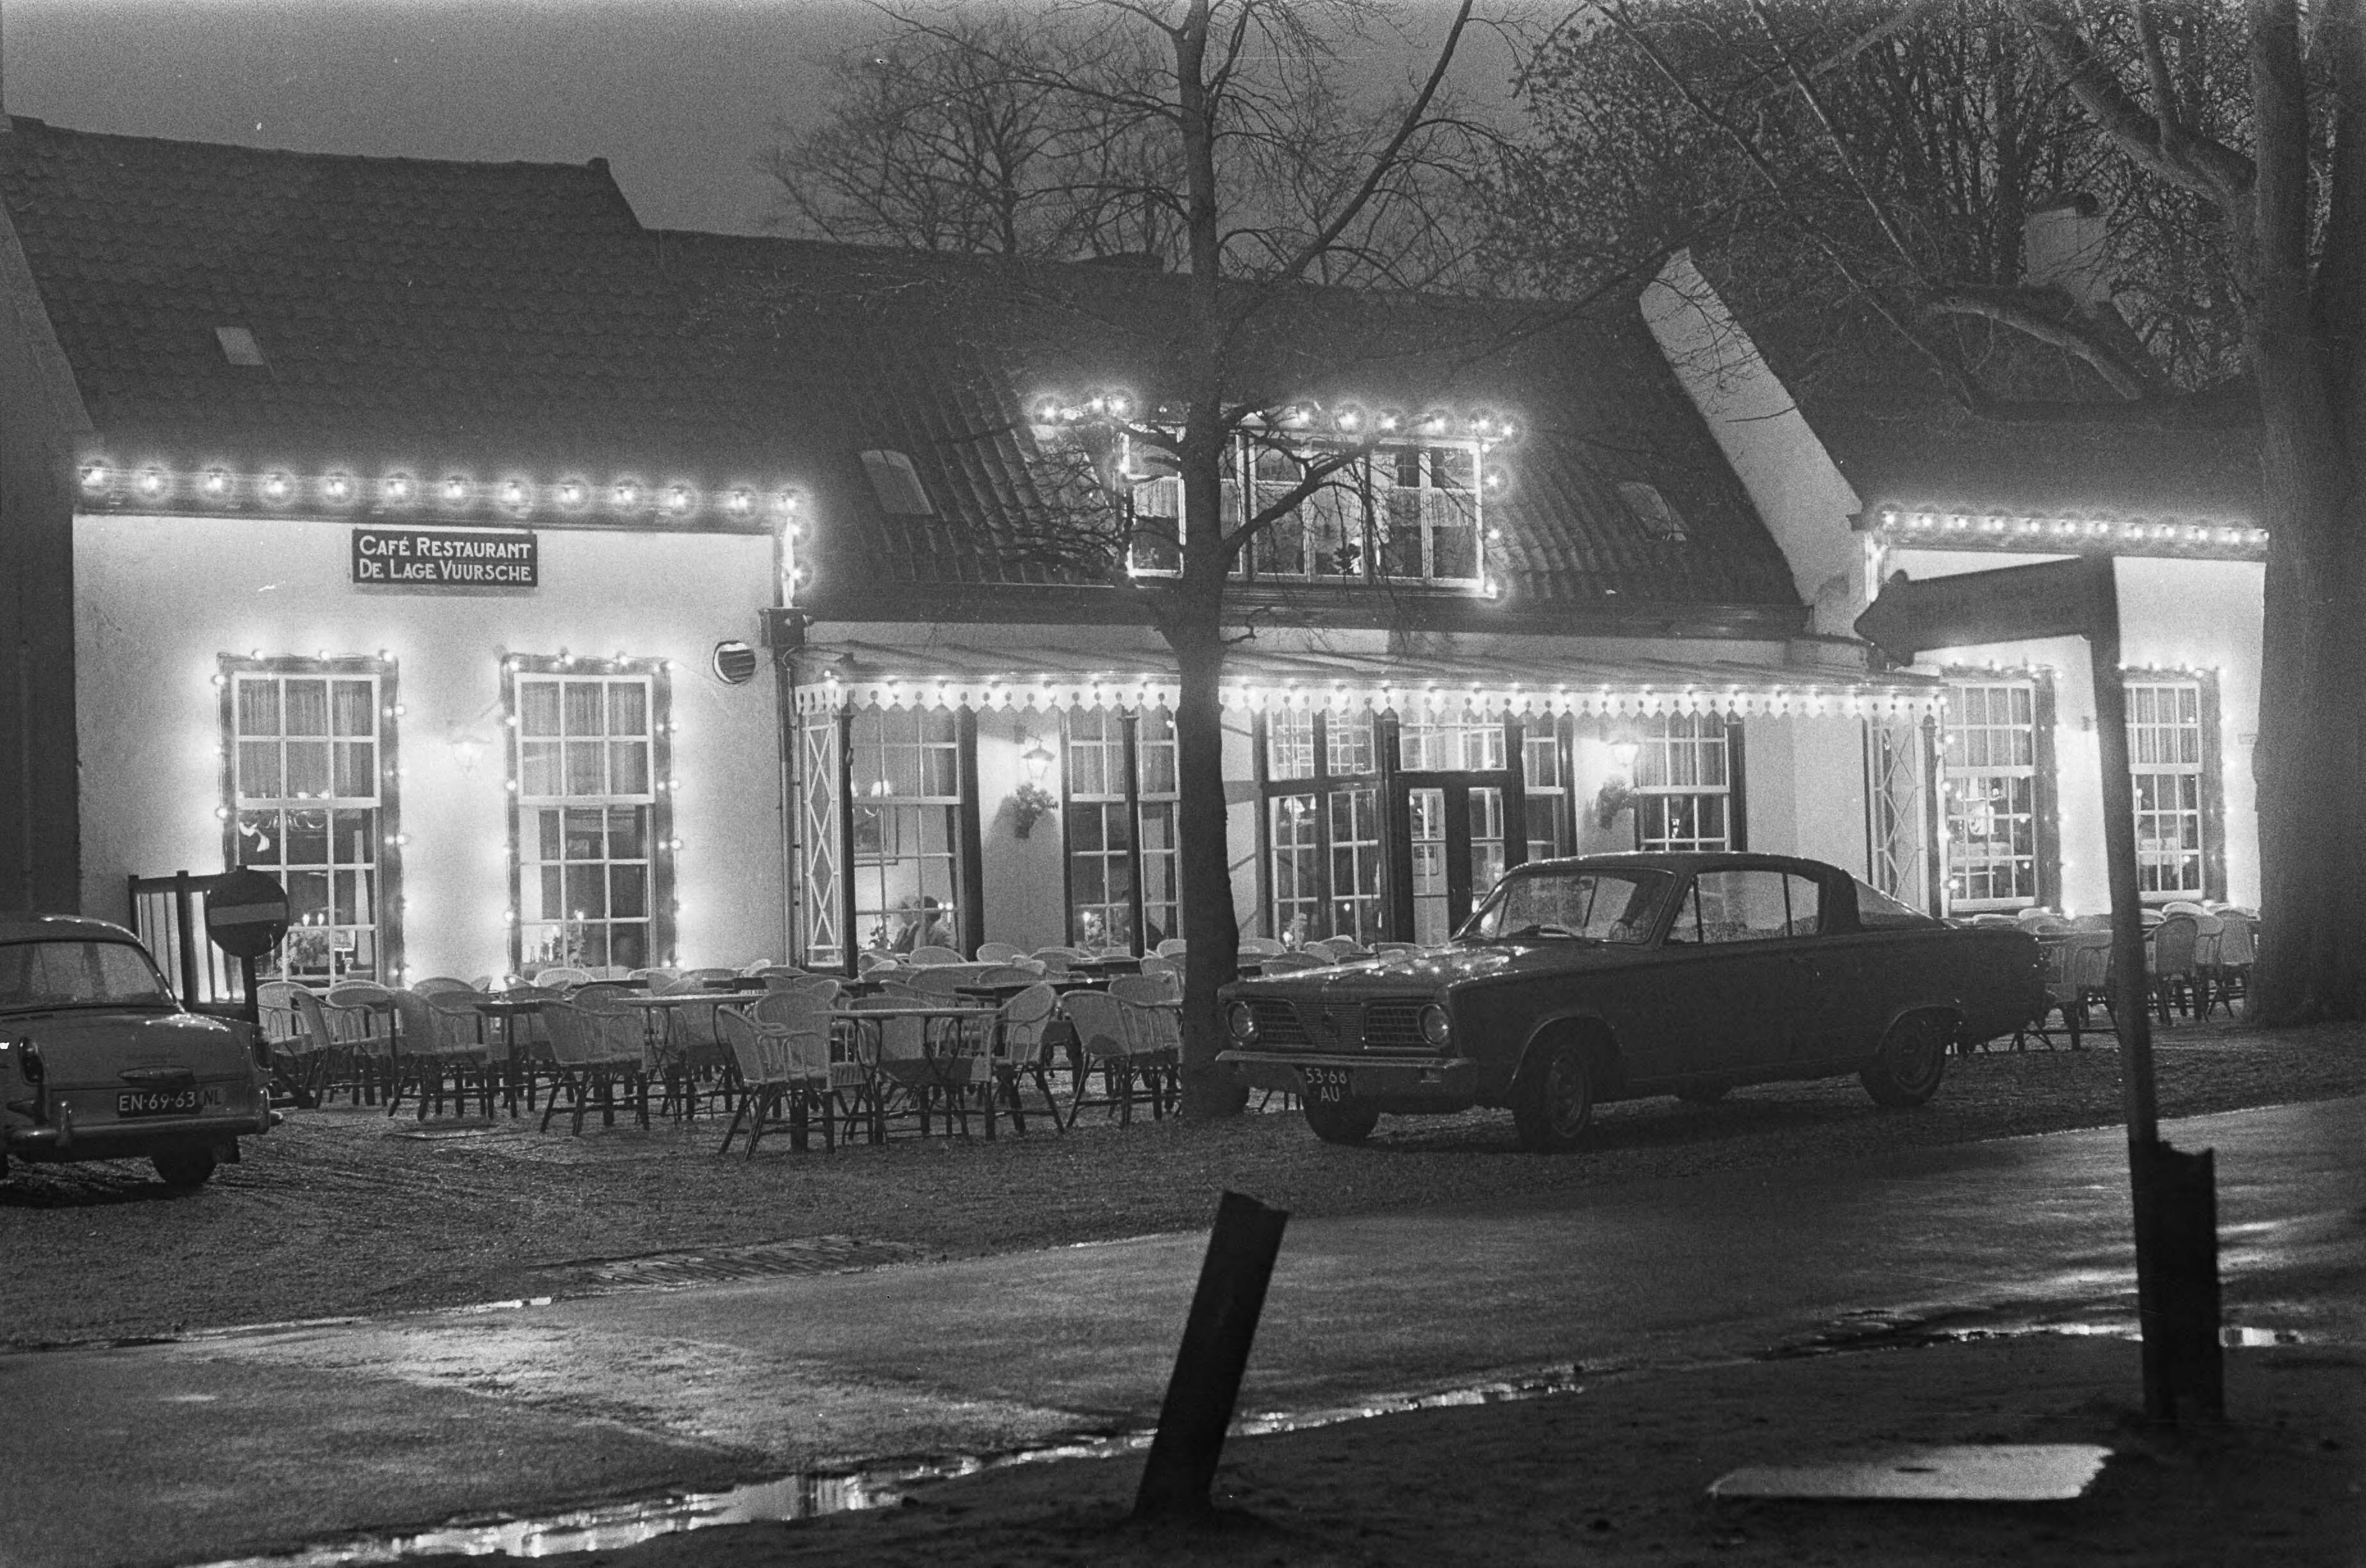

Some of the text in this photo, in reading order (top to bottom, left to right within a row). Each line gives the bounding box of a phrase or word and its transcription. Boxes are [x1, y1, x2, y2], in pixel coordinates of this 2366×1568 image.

[417, 537, 531, 559] RESTAURANT
[359, 558, 532, 581] DE LAGE VUURSCHE
[203, 1088, 222, 1106] NL
[1320, 1086, 1340, 1103] AU
